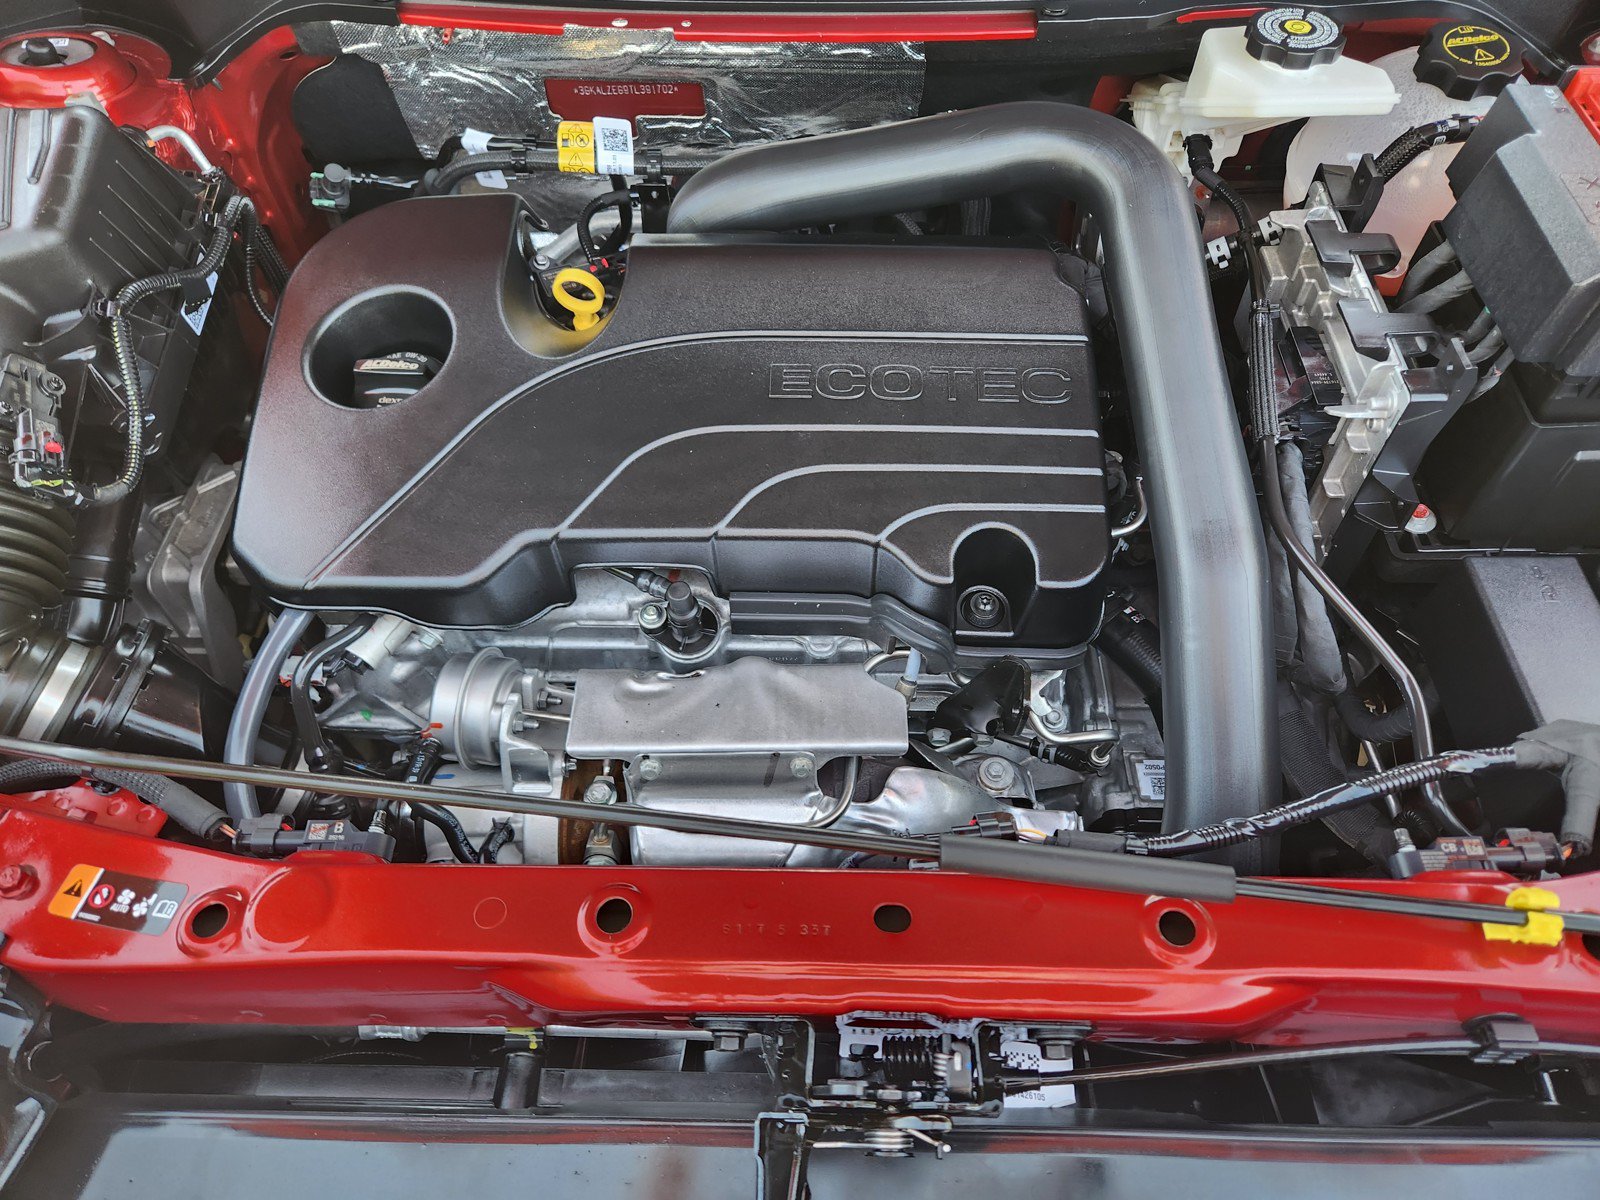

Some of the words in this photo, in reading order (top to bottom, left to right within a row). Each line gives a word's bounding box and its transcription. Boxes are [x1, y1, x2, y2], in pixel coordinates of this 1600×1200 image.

[360, 359, 419, 370] ACDelco
[768, 363, 1072, 405] ECOTEC
[333, 821, 344, 834] B
